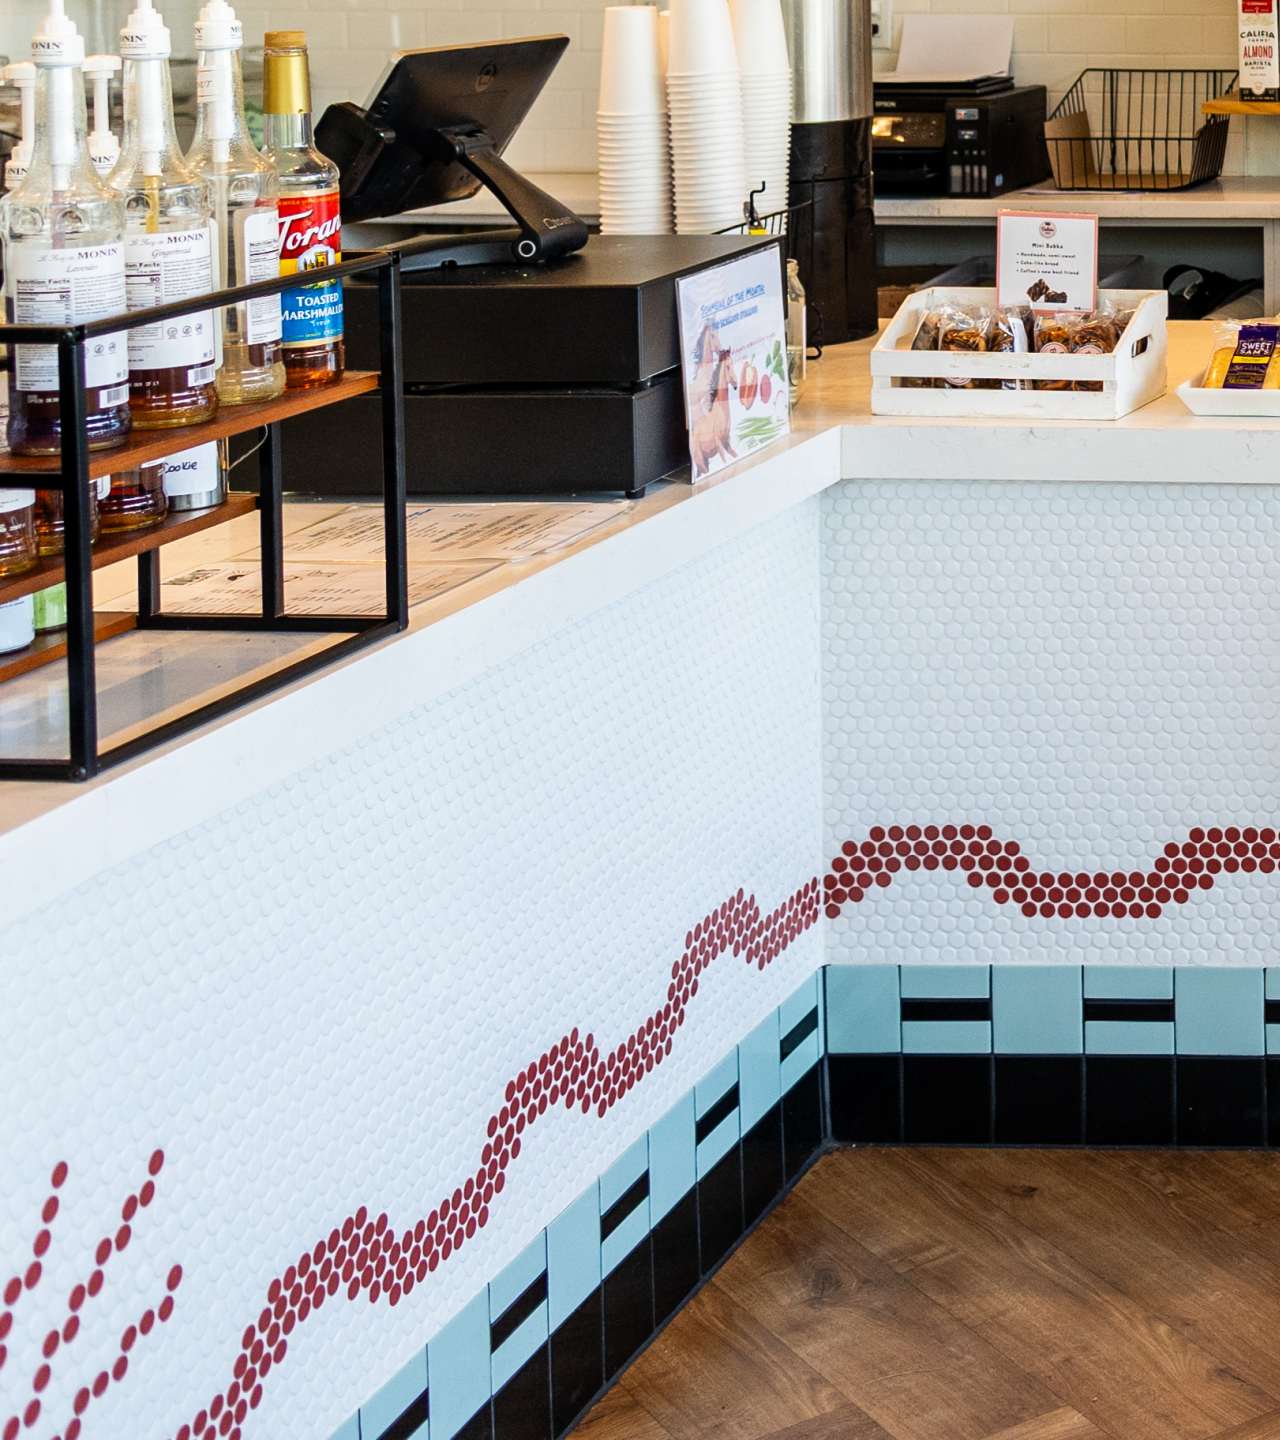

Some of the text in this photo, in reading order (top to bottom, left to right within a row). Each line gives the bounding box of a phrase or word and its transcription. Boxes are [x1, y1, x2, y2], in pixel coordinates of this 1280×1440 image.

[1240, 30, 1275, 39] CALIFIA
[1243, 46, 1273, 59] ALMOND
[166, 232, 206, 245] MONIN
[278, 209, 341, 258] Toran
[77, 247, 119, 261] MONIN
[296, 292, 339, 308] TOASTED
[1241, 342, 1272, 352] SWEET
